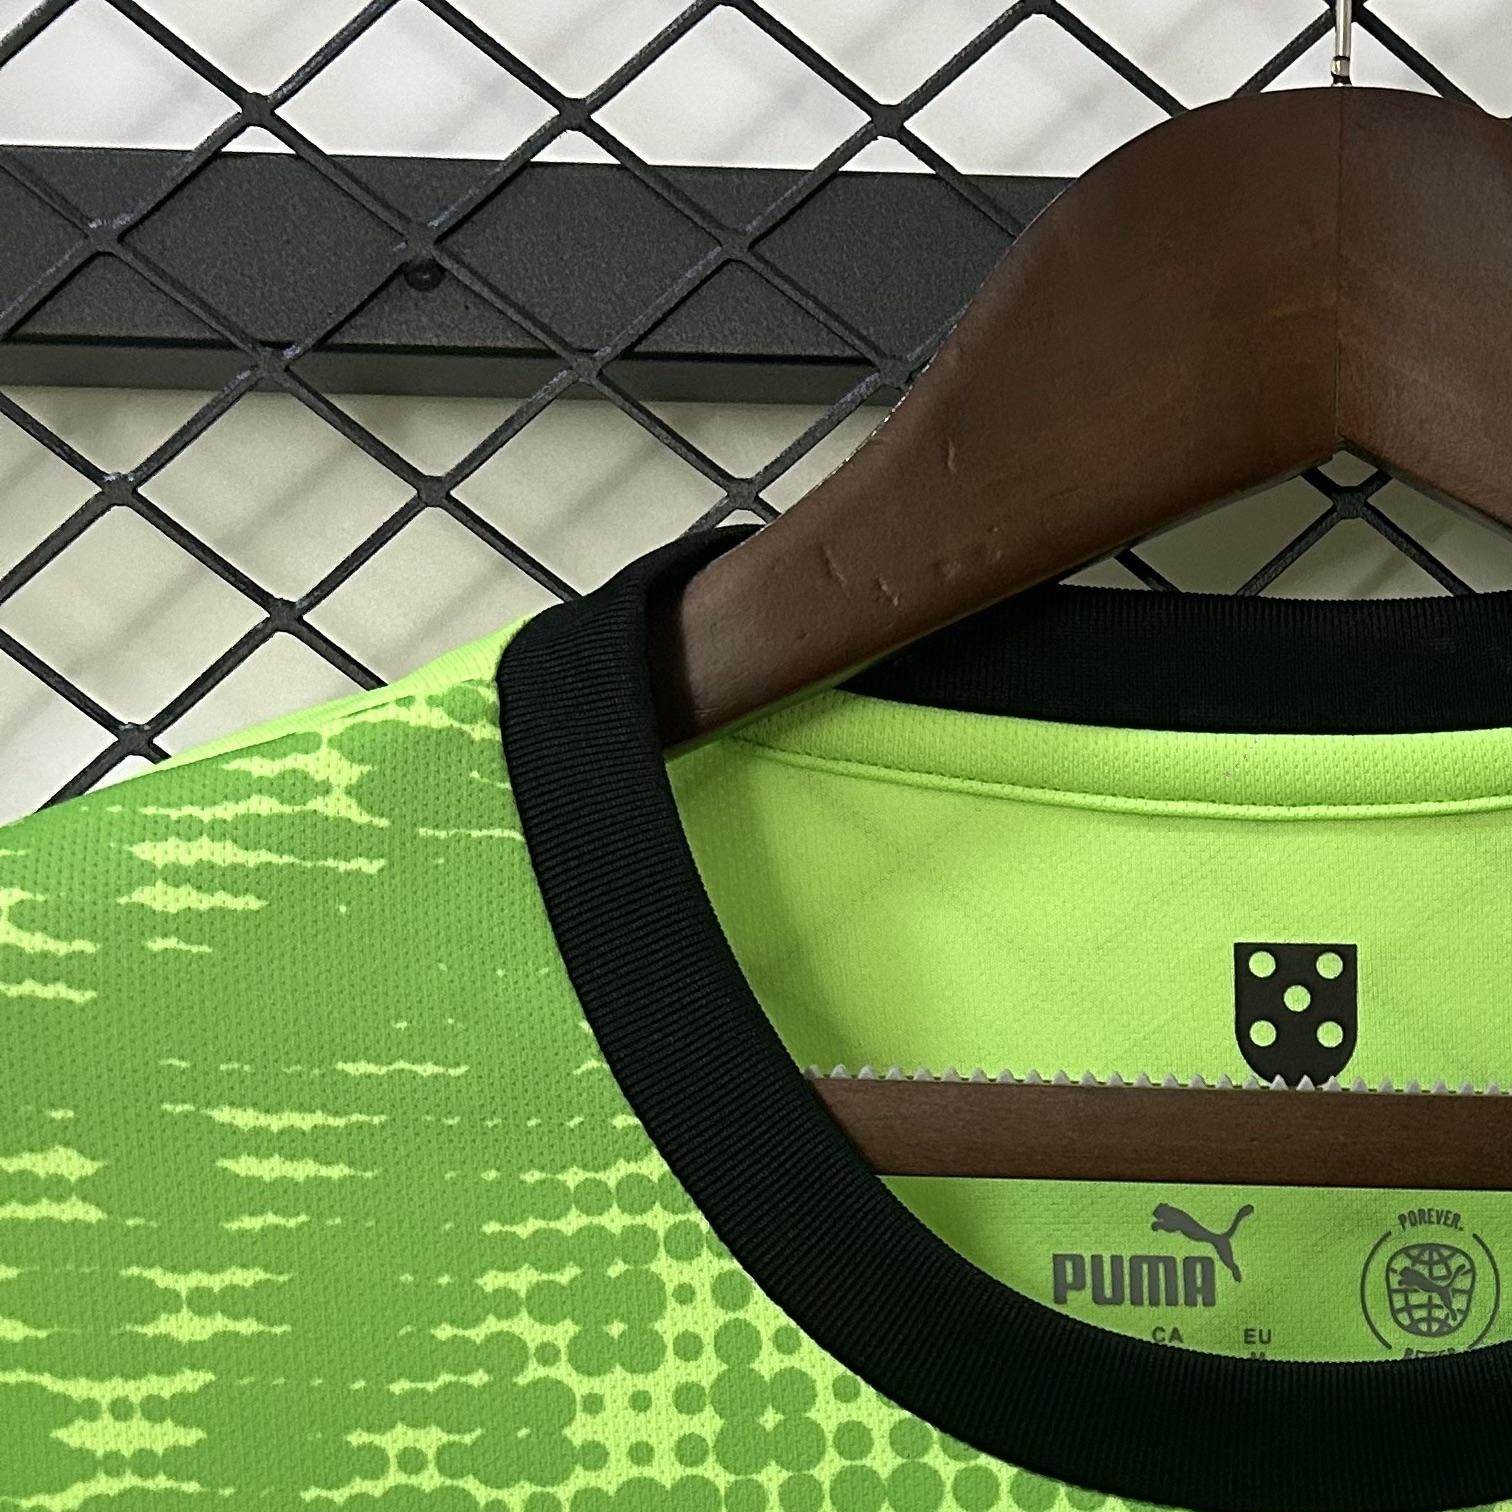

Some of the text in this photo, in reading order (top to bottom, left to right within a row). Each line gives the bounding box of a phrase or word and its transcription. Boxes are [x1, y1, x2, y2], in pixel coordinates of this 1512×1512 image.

[1052, 1253, 1216, 1307] PUMA
[1151, 1325, 1184, 1344] CA
[1243, 1327, 1272, 1345] EU
